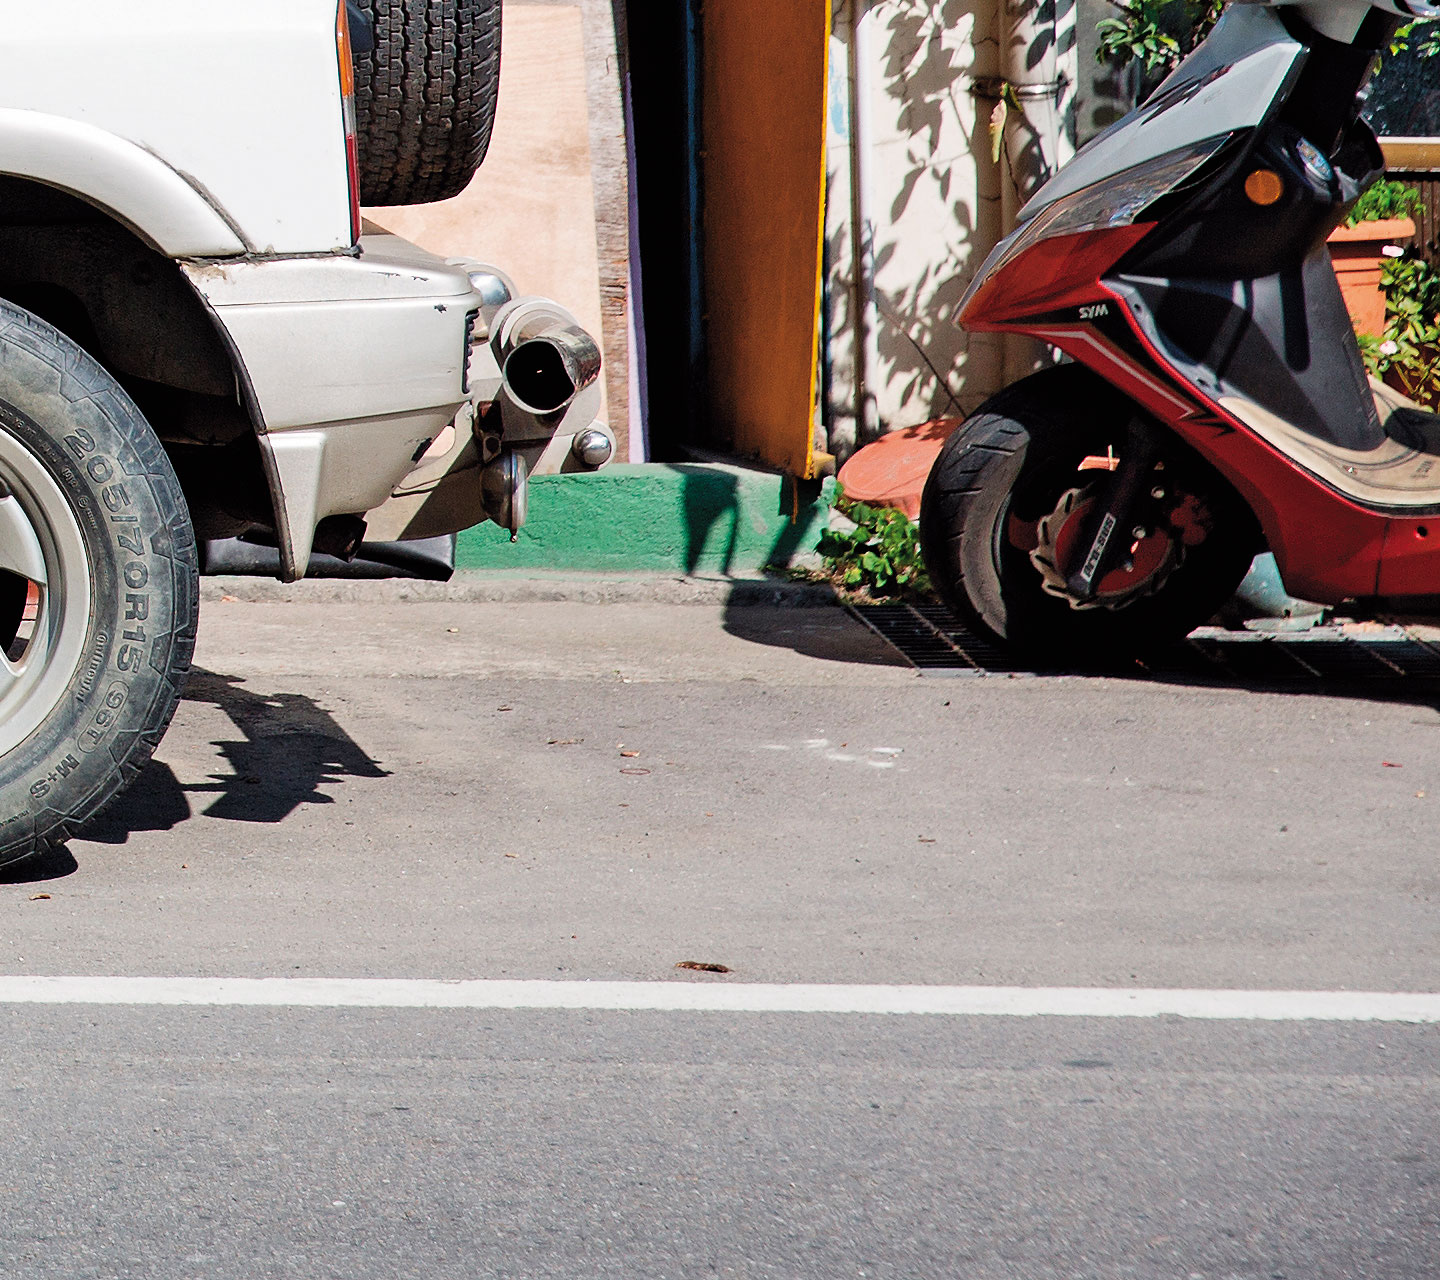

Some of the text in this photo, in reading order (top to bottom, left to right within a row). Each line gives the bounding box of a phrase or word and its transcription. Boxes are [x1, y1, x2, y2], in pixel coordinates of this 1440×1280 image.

[1078, 304, 1109, 319] SYM
[29, 427, 150, 800] 205/70R15 96T M+S
